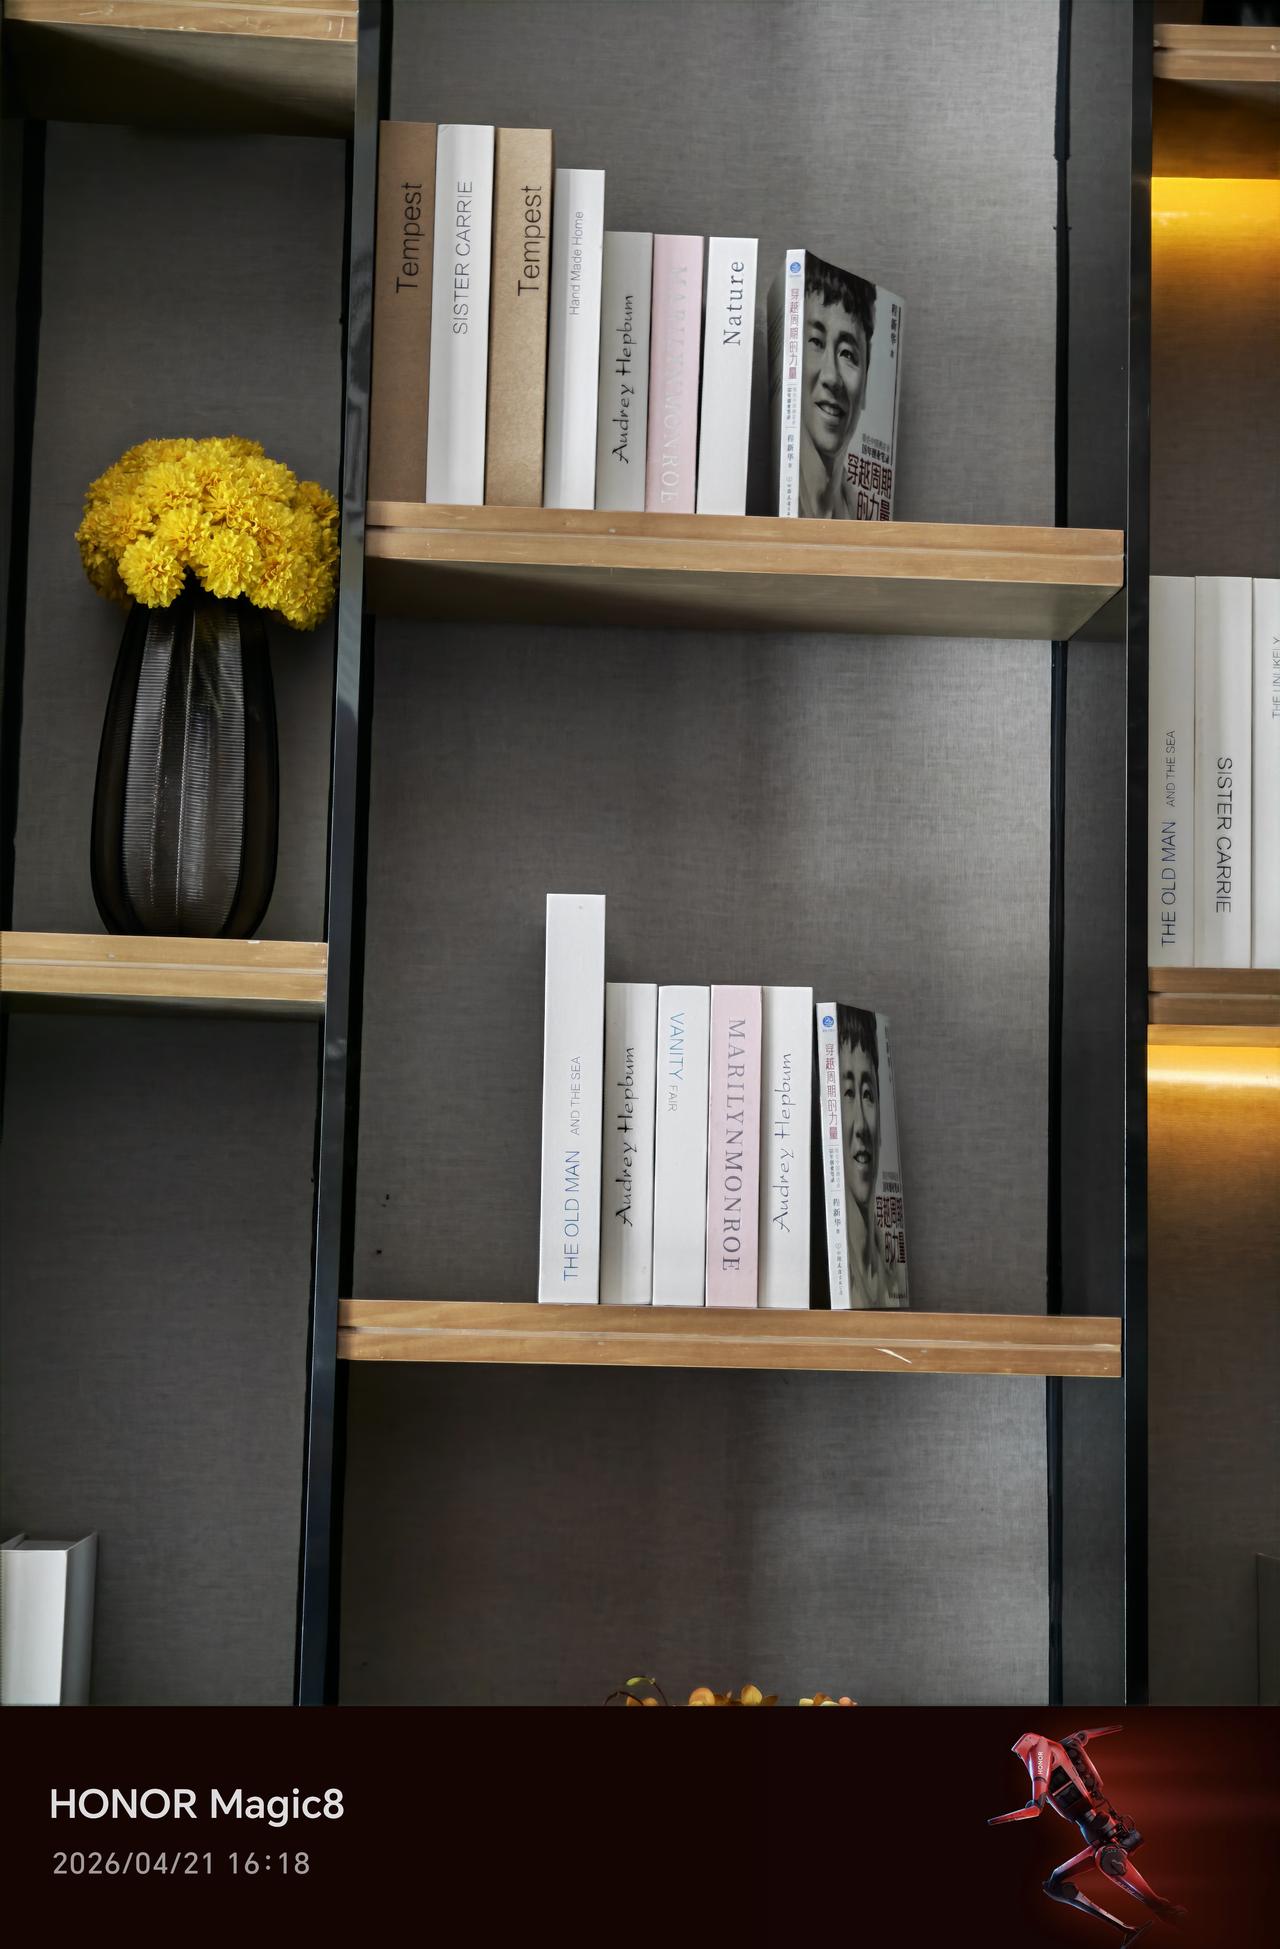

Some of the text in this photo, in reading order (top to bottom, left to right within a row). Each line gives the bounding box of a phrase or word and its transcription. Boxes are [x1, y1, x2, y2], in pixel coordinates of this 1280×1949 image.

[395, 182, 425, 294] Tempest
[452, 181, 473, 335] SISTER CARRIE
[517, 185, 546, 297] Tempest
[569, 211, 585, 316] Hand Made Home
[722, 261, 745, 346] Nature
[611, 383, 636, 464] Audrey
[846, 452, 893, 500] 穿越周期
[1161, 730, 1176, 948] THE OLD MAN AND THE SEA
[1216, 757, 1233, 914] SISTER CARRIE
[667, 1012, 685, 1112] VANITY FAIR
[825, 1043, 838, 1140] 穿越周期的力量
[563, 1056, 581, 1282] THE OLD MAN AND THE SEA
[615, 1141, 638, 1228] Audrey
[722, 1018, 746, 1271] MARILYNMONROE
[772, 1148, 795, 1233] Audrey
